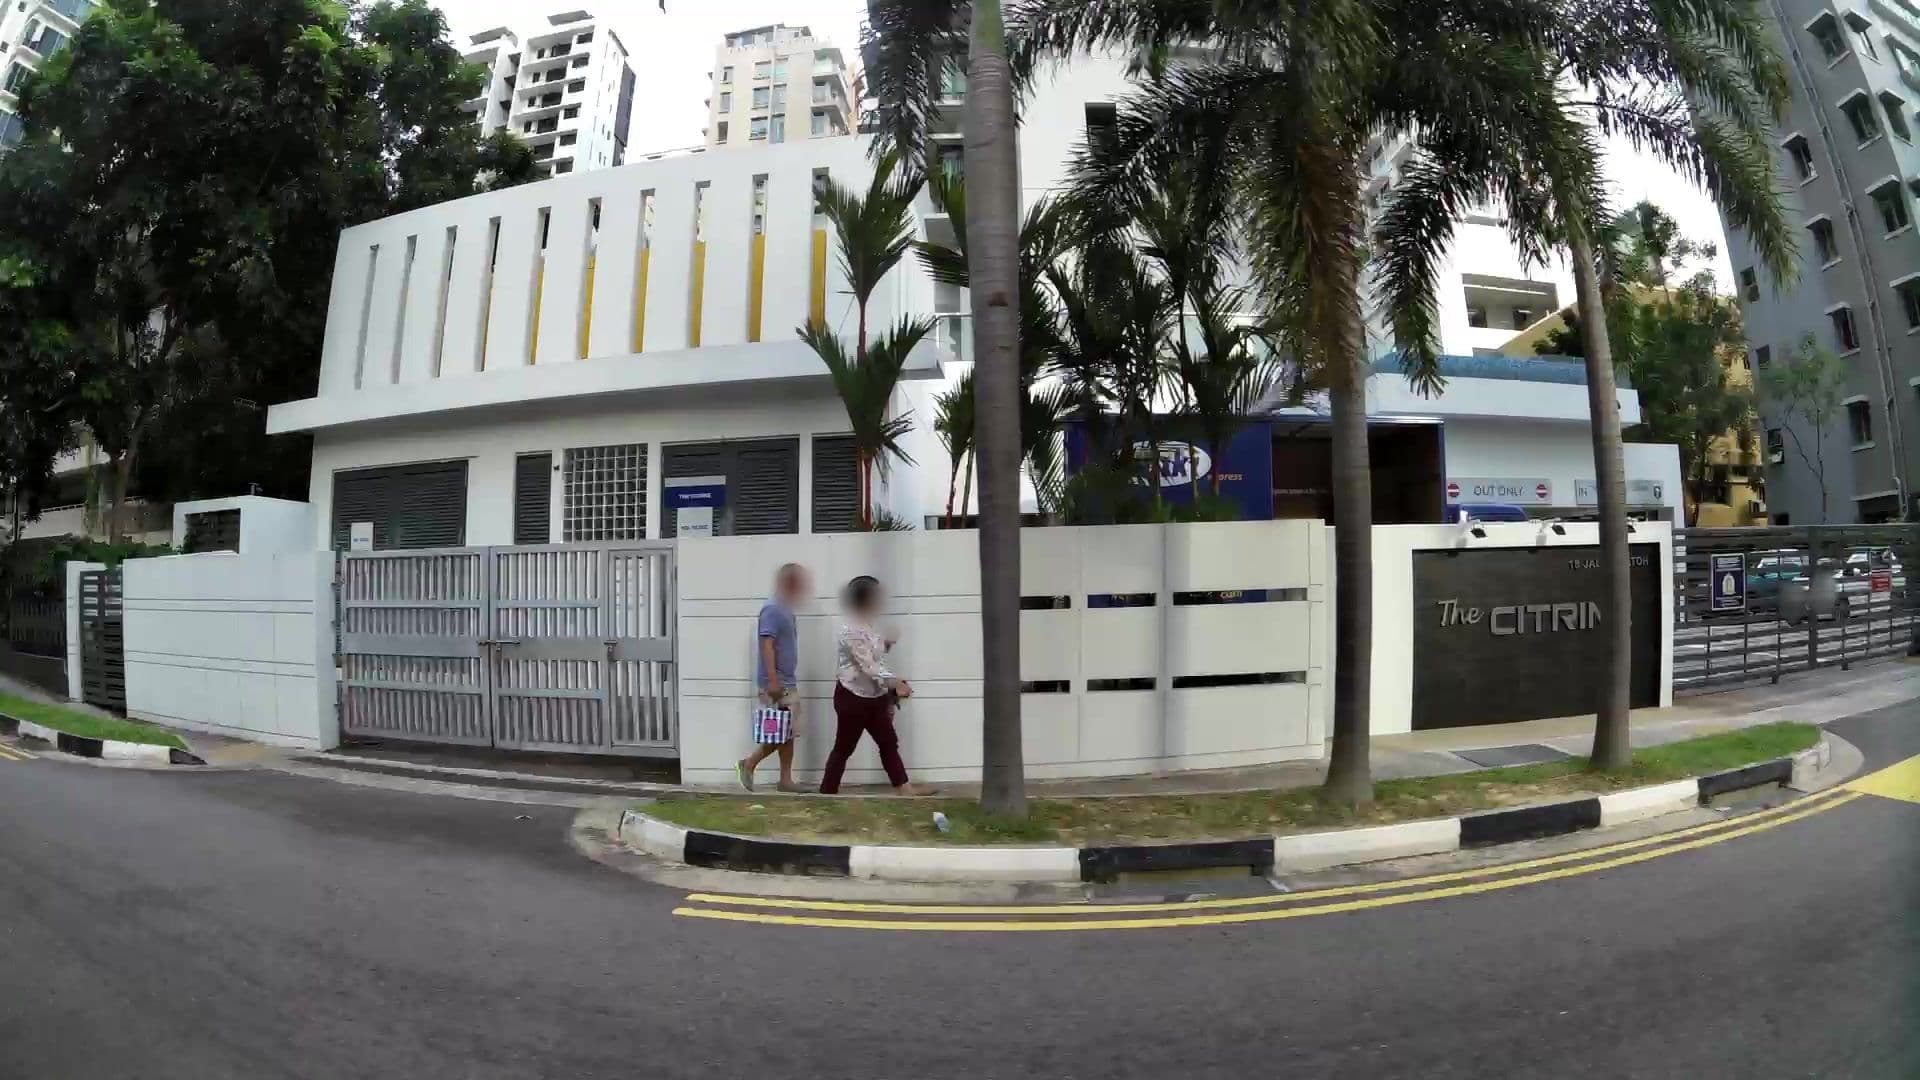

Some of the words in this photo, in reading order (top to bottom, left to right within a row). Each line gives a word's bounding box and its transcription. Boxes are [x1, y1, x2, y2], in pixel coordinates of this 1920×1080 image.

[1473, 486, 1495, 496] OUT
[1498, 486, 1524, 496] ONLY
[1578, 487, 1588, 497] IN
[1583, 559, 1600, 569] JAL
[1438, 598, 1484, 627] The
